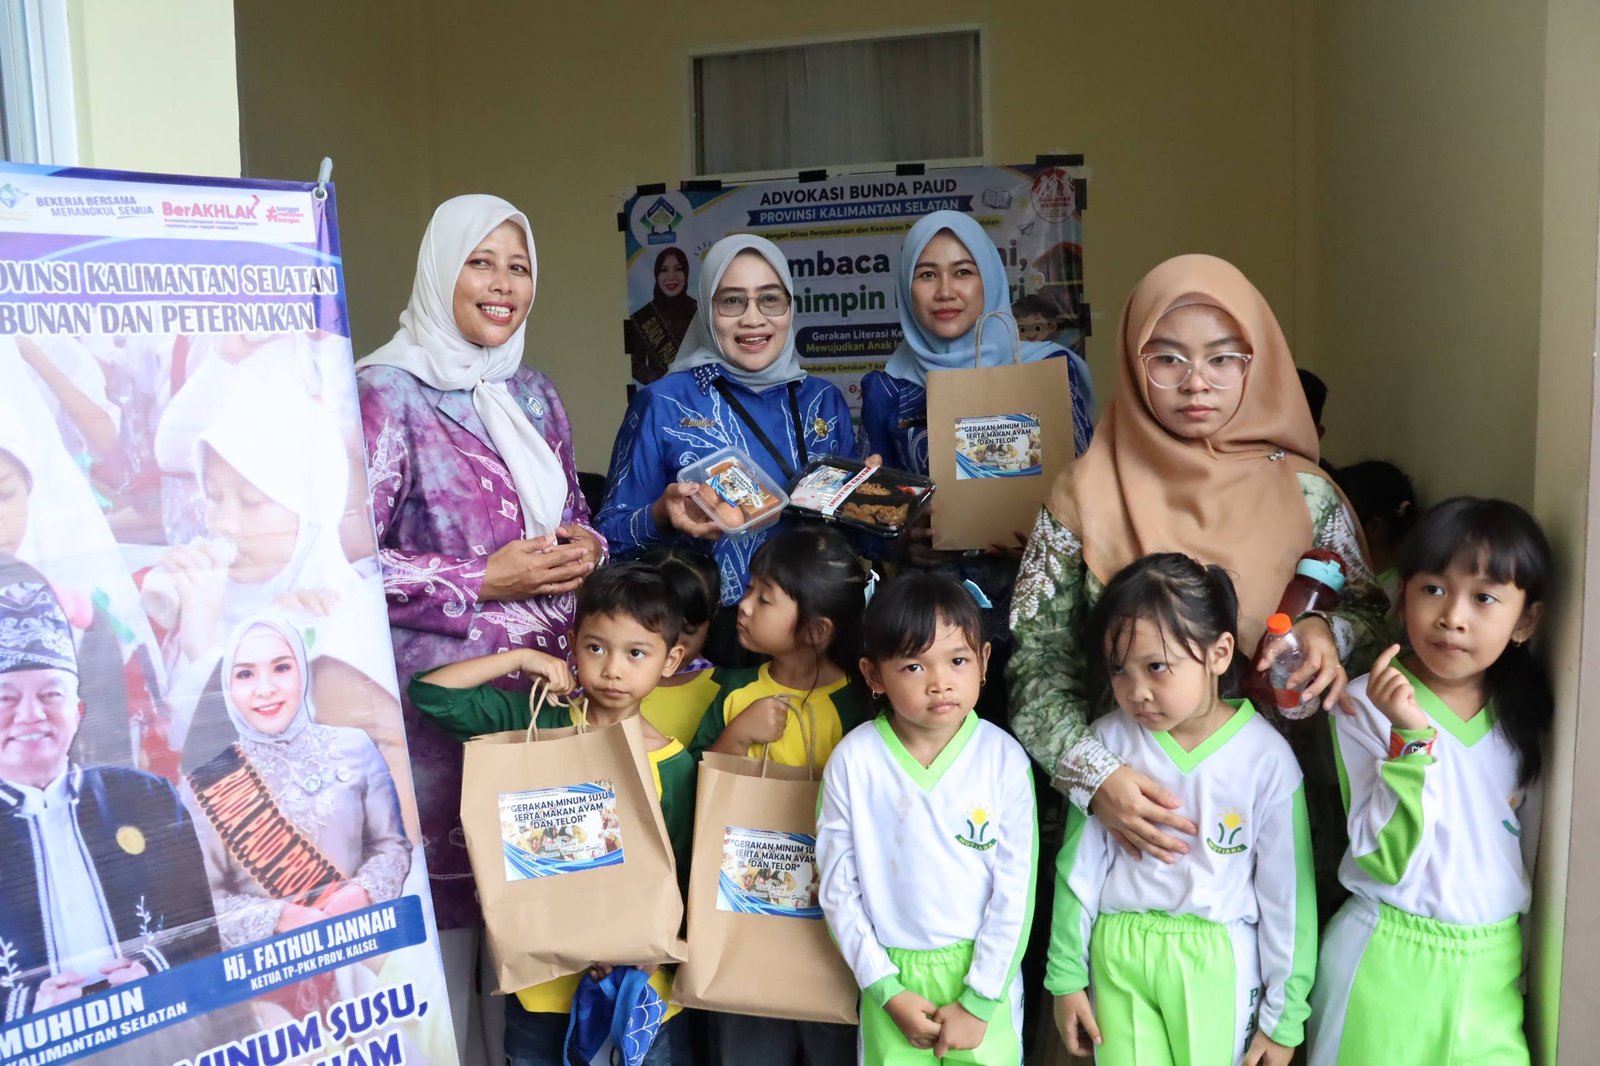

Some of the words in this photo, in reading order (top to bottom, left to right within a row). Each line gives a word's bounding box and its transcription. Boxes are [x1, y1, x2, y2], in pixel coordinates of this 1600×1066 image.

[36, 197, 85, 207] BEKERJA
[86, 195, 137, 206] BERSAMA
[760, 187, 844, 206] ADVOKASI
[850, 182, 907, 199] BUNDA
[913, 179, 957, 195] PAUD
[51, 207, 116, 216] MERANGKUL
[118, 206, 154, 215] SEMUA
[162, 196, 259, 219] BerAKHLAK
[760, 209, 816, 223] PROVINSI
[820, 203, 900, 218] KALIMANTAN
[905, 200, 959, 213] SELATAN
[787, 250, 890, 277] mbaca
[0, 262, 78, 292] VINSI
[86, 264, 237, 293] KALIMANTAN
[243, 266, 335, 293] SELATAN
[793, 284, 885, 317] impin
[0, 304, 91, 334] BUNAN
[100, 304, 153, 333] DAN
[161, 304, 314, 333] PETERNAKAN
[812, 331, 850, 340] Gerakan
[853, 329, 888, 339] Literasi
[806, 342, 864, 353] Mewujudkan
[867, 341, 890, 350] Anak
[962, 424, 995, 432] "GERAKAN
[507, 800, 553, 812] "GERAKAN
[556, 795, 587, 806] MINUM
[589, 792, 608, 801] SUSU
[514, 812, 540, 822] SERTA
[543, 808, 575, 819] MAKAN
[578, 802, 604, 813] AYAM
[202, 767, 265, 835] BUNDA
[234, 808, 292, 868] PAUD
[556, 814, 587, 826] TELOR"
[731, 839, 774, 850] "GERAKAN
[776, 843, 803, 853] MINUM
[806, 846, 815, 854] SU
[959, 837, 993, 851] MUTIARA
[1208, 840, 1243, 854] MUTIARA
[736, 850, 759, 858] SERTA
[762, 852, 791, 861] MAKAN
[794, 854, 816, 863] AYAM
[771, 862, 800, 872] TELOR"
[223, 952, 252, 982] Hj.
[253, 929, 324, 972] FATHUL
[327, 907, 397, 948] JANNAH
[250, 972, 281, 991] KETUA
[282, 959, 317, 980] TP-PKK
[318, 953, 345, 970] PROV.
[346, 939, 378, 959] KALSEL
[0, 986, 144, 1060] MUHIDIN
[329, 983, 428, 1042] SUSU,
[5, 1026, 117, 1066] ALIMANTAN
[120, 1001, 187, 1035] SELATAN
